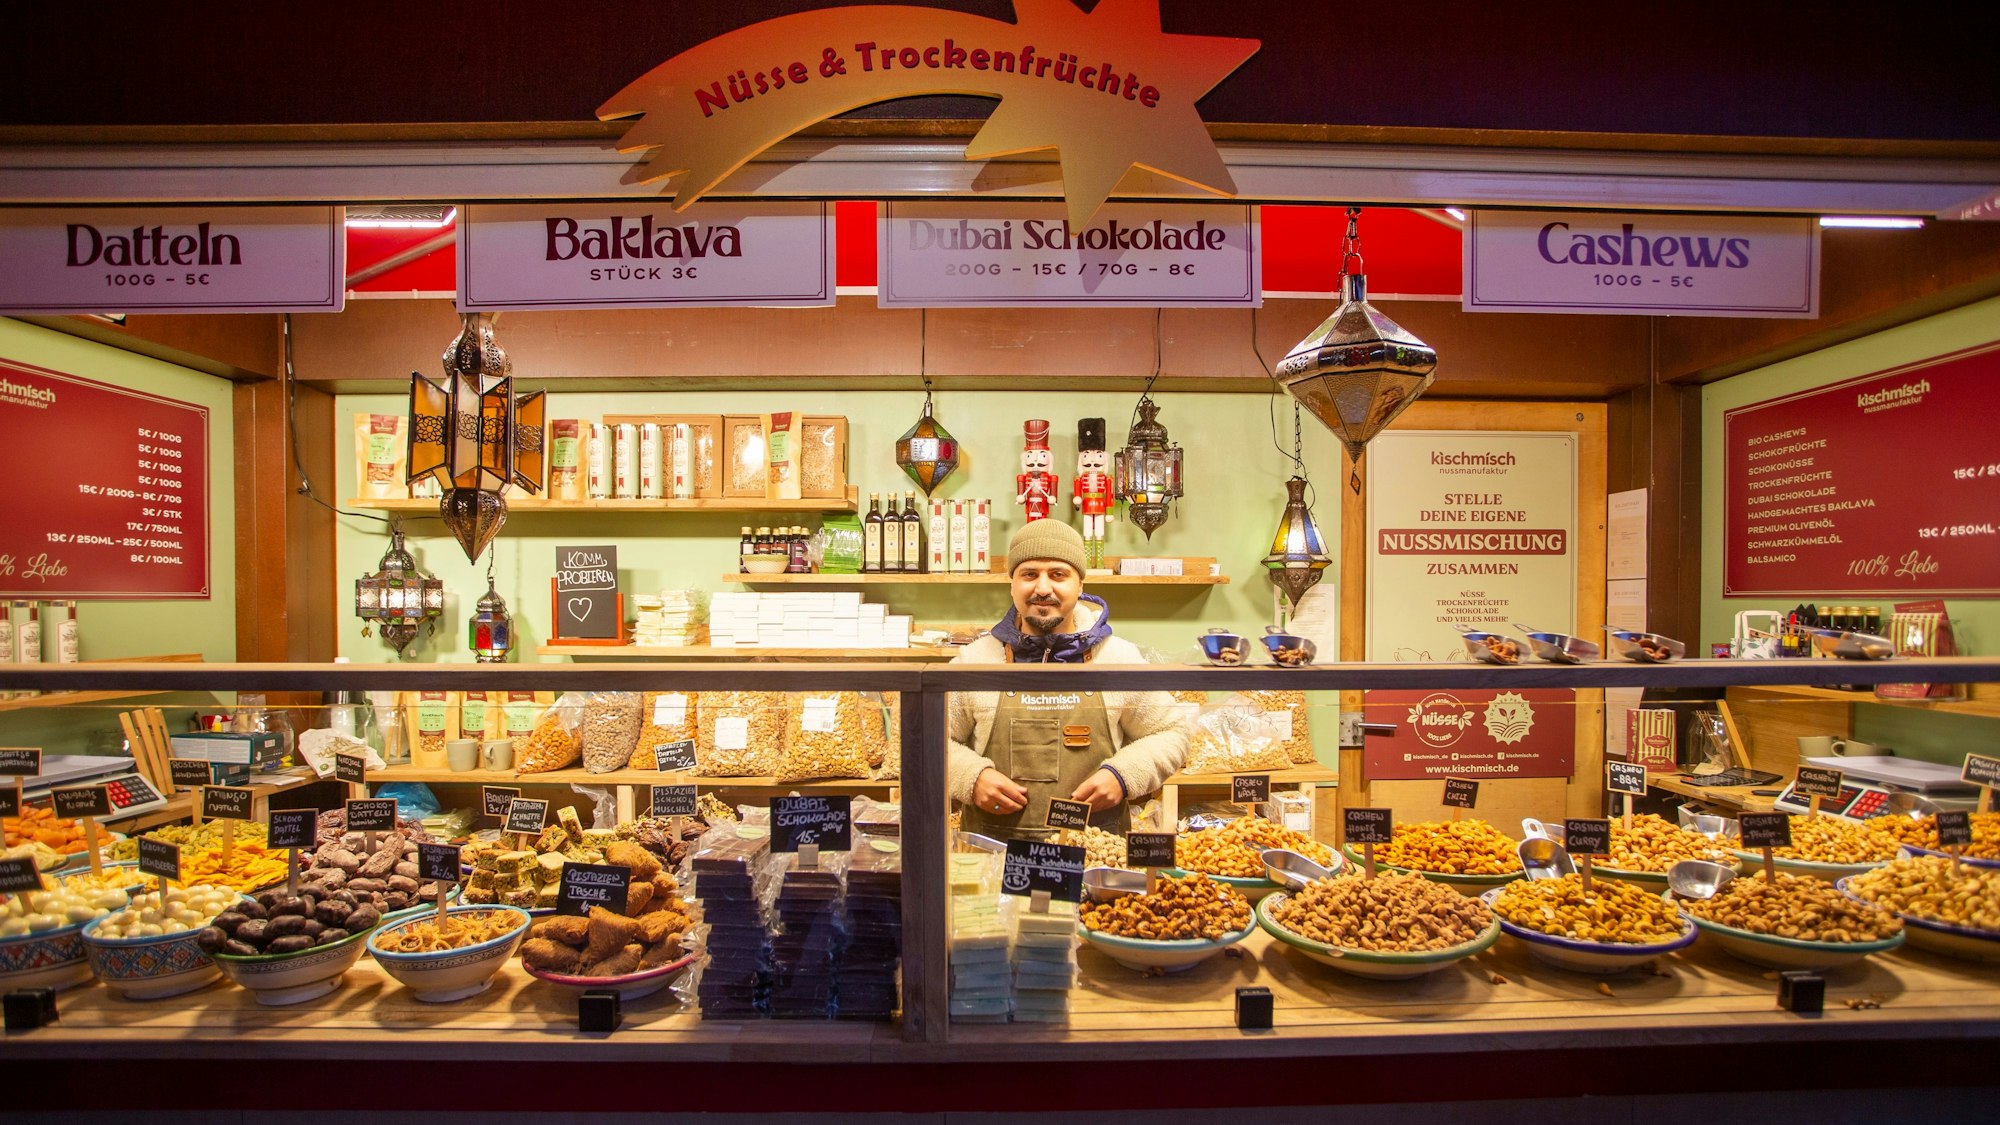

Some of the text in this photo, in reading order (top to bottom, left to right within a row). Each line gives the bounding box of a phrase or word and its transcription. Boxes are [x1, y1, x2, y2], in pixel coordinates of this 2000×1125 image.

[694, 38, 1162, 117] Nüsse & Trockenfrüchte
[545, 214, 743, 261] Baklava
[909, 218, 1227, 253] Dubai Schokolade
[67, 222, 243, 267] Datteln
[1536, 221, 1752, 270] Cashews
[590, 265, 698, 281] STÜCK 3€
[944, 263, 1002, 277] 200G
[1032, 263, 1068, 276] 15€
[1098, 263, 1139, 277] 70G
[1169, 262, 1196, 276] 8€
[105, 273, 156, 286] 100G
[185, 273, 210, 286] 5€
[1593, 273, 1643, 288] 100G
[1669, 274, 1695, 288] 5€
[1863, 395, 1922, 414] nussmanufaktur
[138, 428, 152, 438] 5€
[159, 432, 182, 443] 100G
[1748, 427, 1807, 446] BIO CASHEWS
[138, 444, 152, 454] 5€
[159, 448, 182, 459] 100G
[1748, 439, 1827, 461] SCHOKOFRÜCHTE
[138, 460, 152, 469] 5€
[159, 463, 182, 474] 100G
[1439, 467, 1508, 475] nussmanufaktur
[1748, 457, 1814, 476] SCHOKONÜSSE
[1953, 467, 1975, 480] 15€
[138, 475, 152, 485] 5€
[159, 479, 182, 489] 100G
[1748, 470, 1833, 490] TROCKENFRÜCHTE
[79, 484, 97, 494] 15€
[107, 488, 134, 498] 200G
[143, 492, 156, 501] 8€
[164, 495, 182, 504] 70G
[1444, 493, 1503, 505] STELLE
[1748, 486, 1837, 505] DUBAI SCHOKOLADE
[142, 508, 156, 517] 3€
[163, 510, 182, 519] STK
[1420, 510, 1527, 522] DEINE EIGENE
[1748, 498, 1875, 520] HANDGEMACHTES BAKLAVA
[127, 522, 143, 532] 17€
[151, 524, 182, 534] 750ML
[1748, 519, 1835, 534] PREMIUM OLIVENÖL
[1918, 527, 1939, 538] 13€
[1950, 524, 1995, 537] 250ML
[47, 533, 67, 543] 13€
[77, 534, 114, 545] 250ML
[123, 538, 142, 548] 25€
[150, 539, 182, 550] 500ML
[1382, 534, 1563, 551] NUSSMISCHUNG
[1748, 534, 1843, 549] SCHWARZKÜMMELÖL
[130, 554, 144, 563] 8€
[152, 555, 183, 565] 100ML
[569, 551, 603, 567] KOMM
[1748, 555, 1796, 564] BALSAMICO
[1847, 550, 1939, 581] 100% Liebe
[22, 553, 68, 583] Liebe
[1426, 563, 1519, 575] ZUSAMMEN
[557, 569, 614, 589] PROBIEREN
[1460, 590, 1486, 598] NÜSSE
[1436, 598, 1509, 606] TROCKENFRÜCHTE
[1446, 607, 1499, 615] SCHOKOLADE
[1436, 615, 1509, 623] UND VIELES MEHR!
[1422, 712, 1458, 726] NÜSSE
[1425, 764, 1520, 775] www.kischmisch.de
[1610, 764, 1643, 774] CASHEW
[778, 797, 827, 812] DUBAI
[1446, 792, 1468, 802] CHILI
[777, 811, 847, 827] SCHOKOLADE
[1029, 843, 1061, 858] NEU!
[1006, 853, 1037, 865] Dubai
[568, 885, 608, 899] TASCHE
